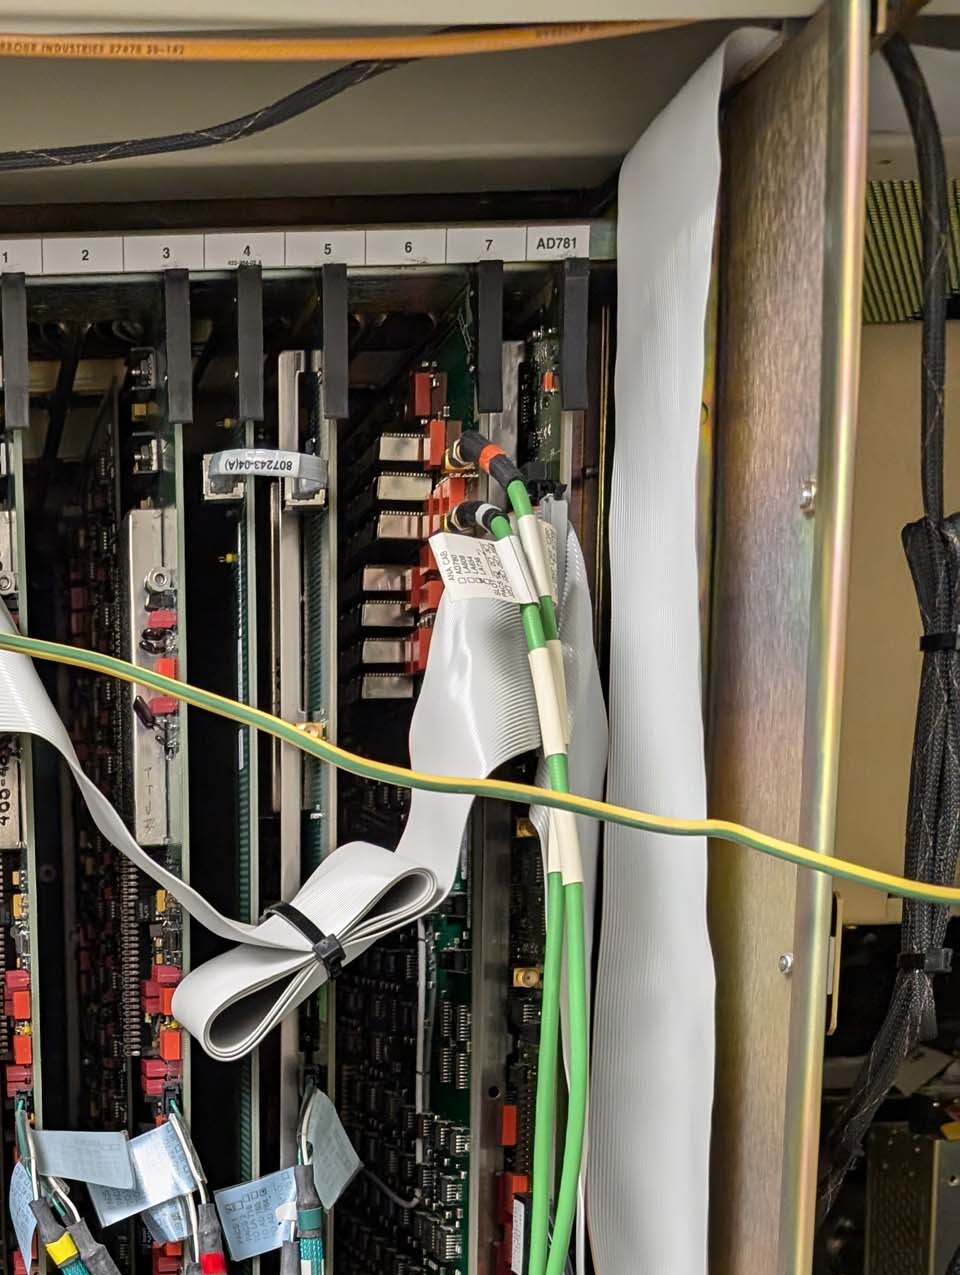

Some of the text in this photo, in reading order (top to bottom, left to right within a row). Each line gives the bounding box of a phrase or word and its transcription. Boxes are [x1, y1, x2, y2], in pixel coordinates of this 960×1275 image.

[2, 252, 8, 264] 1
[81, 250, 89, 261] 2
[162, 247, 171, 259] 3
[243, 246, 251, 257] 4
[323, 244, 332, 256] 5
[404, 242, 413, 254] 6
[485, 240, 494, 252] 7
[537, 237, 576, 249] AD781
[225, 459, 293, 473] 807243-04(A)
